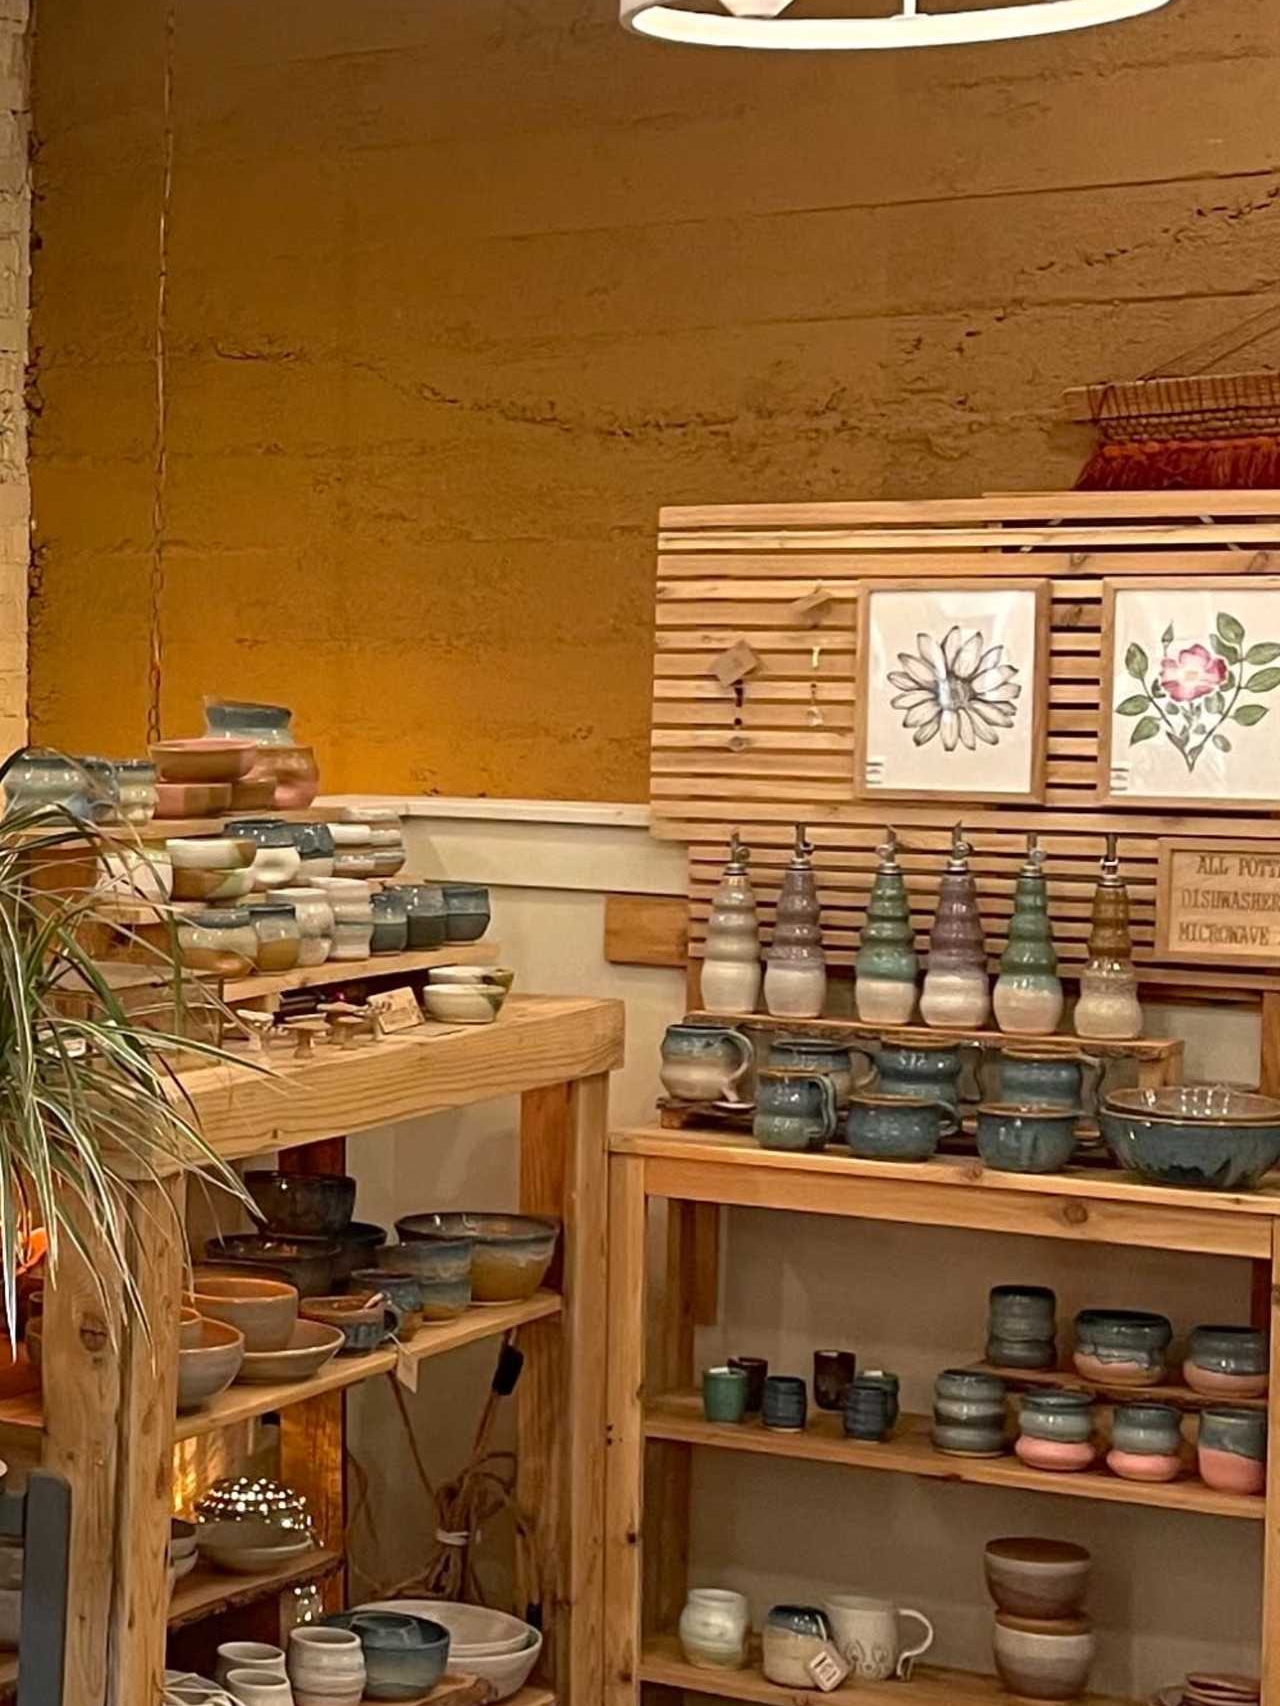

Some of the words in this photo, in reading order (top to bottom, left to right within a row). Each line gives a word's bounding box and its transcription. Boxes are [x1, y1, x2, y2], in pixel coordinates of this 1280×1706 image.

[1196, 854, 1229, 875] ALL
[1238, 856, 1280, 879] POTT
[1178, 920, 1269, 947] MICROWAVE
